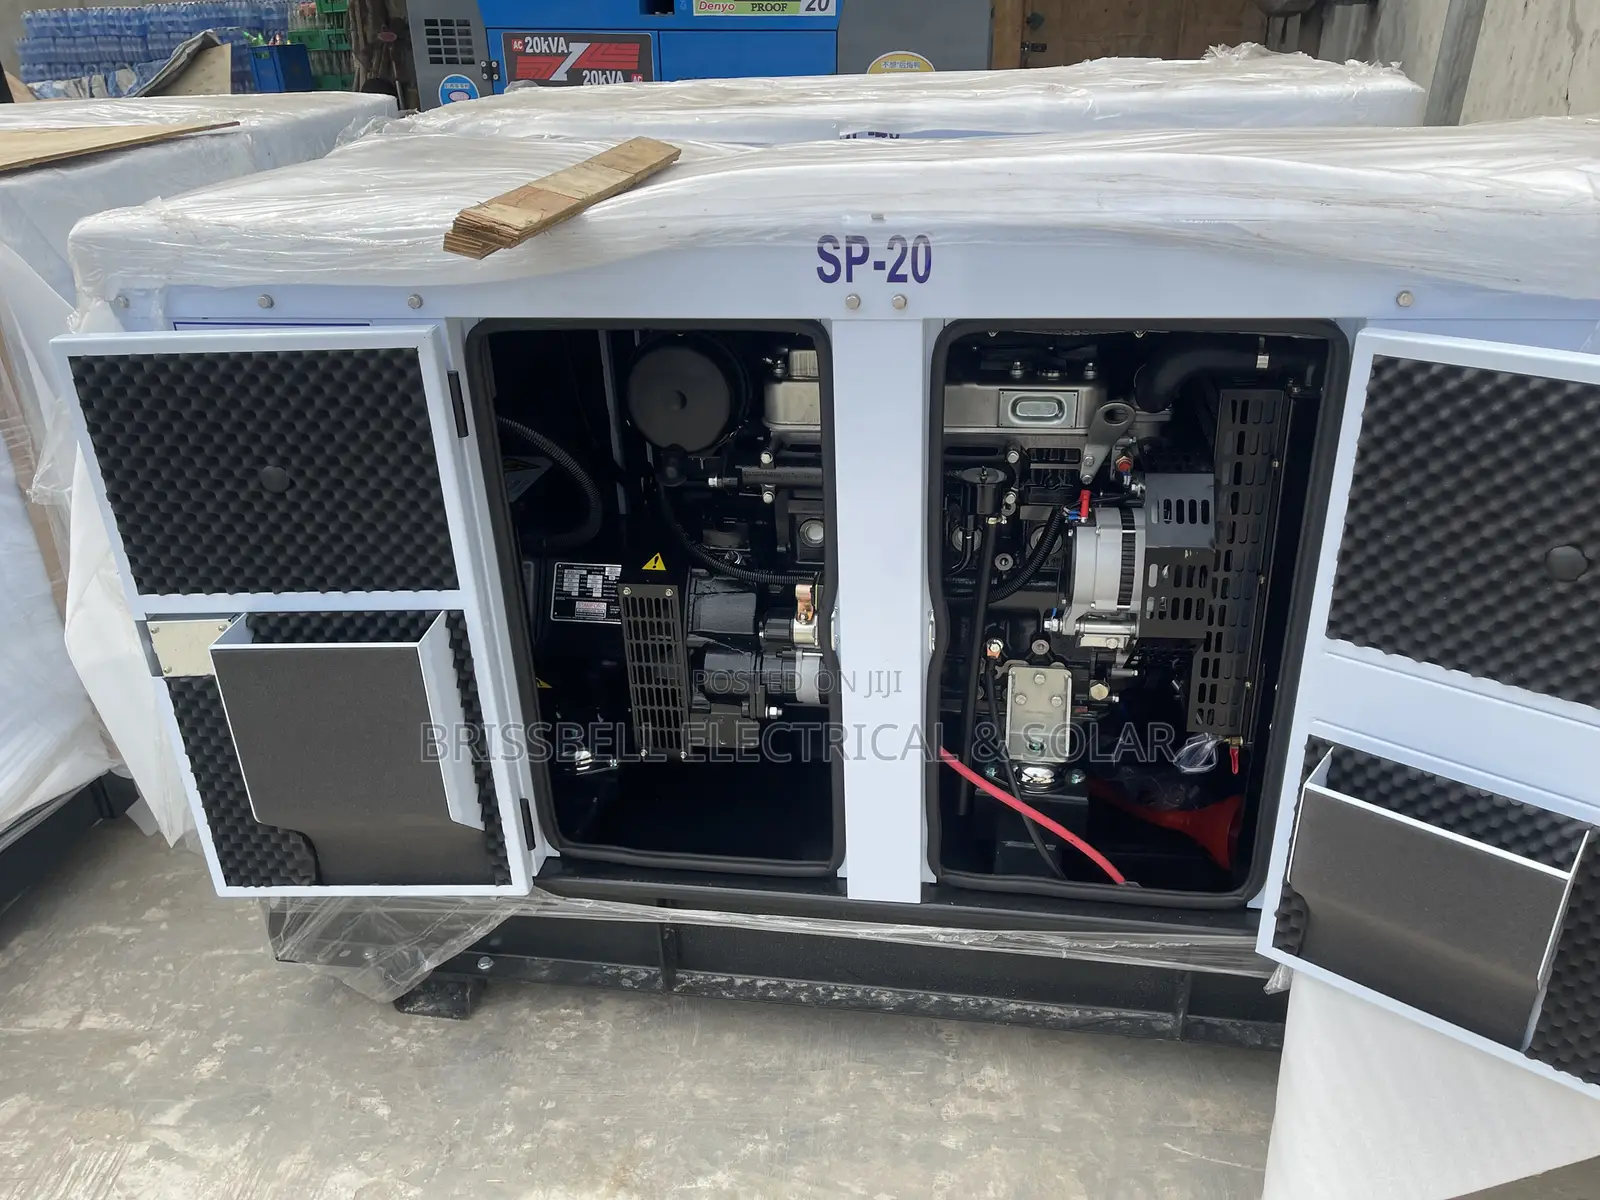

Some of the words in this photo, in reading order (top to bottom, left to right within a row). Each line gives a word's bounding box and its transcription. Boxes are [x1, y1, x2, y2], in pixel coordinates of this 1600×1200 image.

[699, 1, 735, 12] Denyo
[751, 3, 788, 12] PROOF
[513, 40, 523, 50] AC
[525, 36, 569, 53] 20kVA
[582, 70, 625, 86] 20kVA
[816, 234, 932, 284] SP-20
